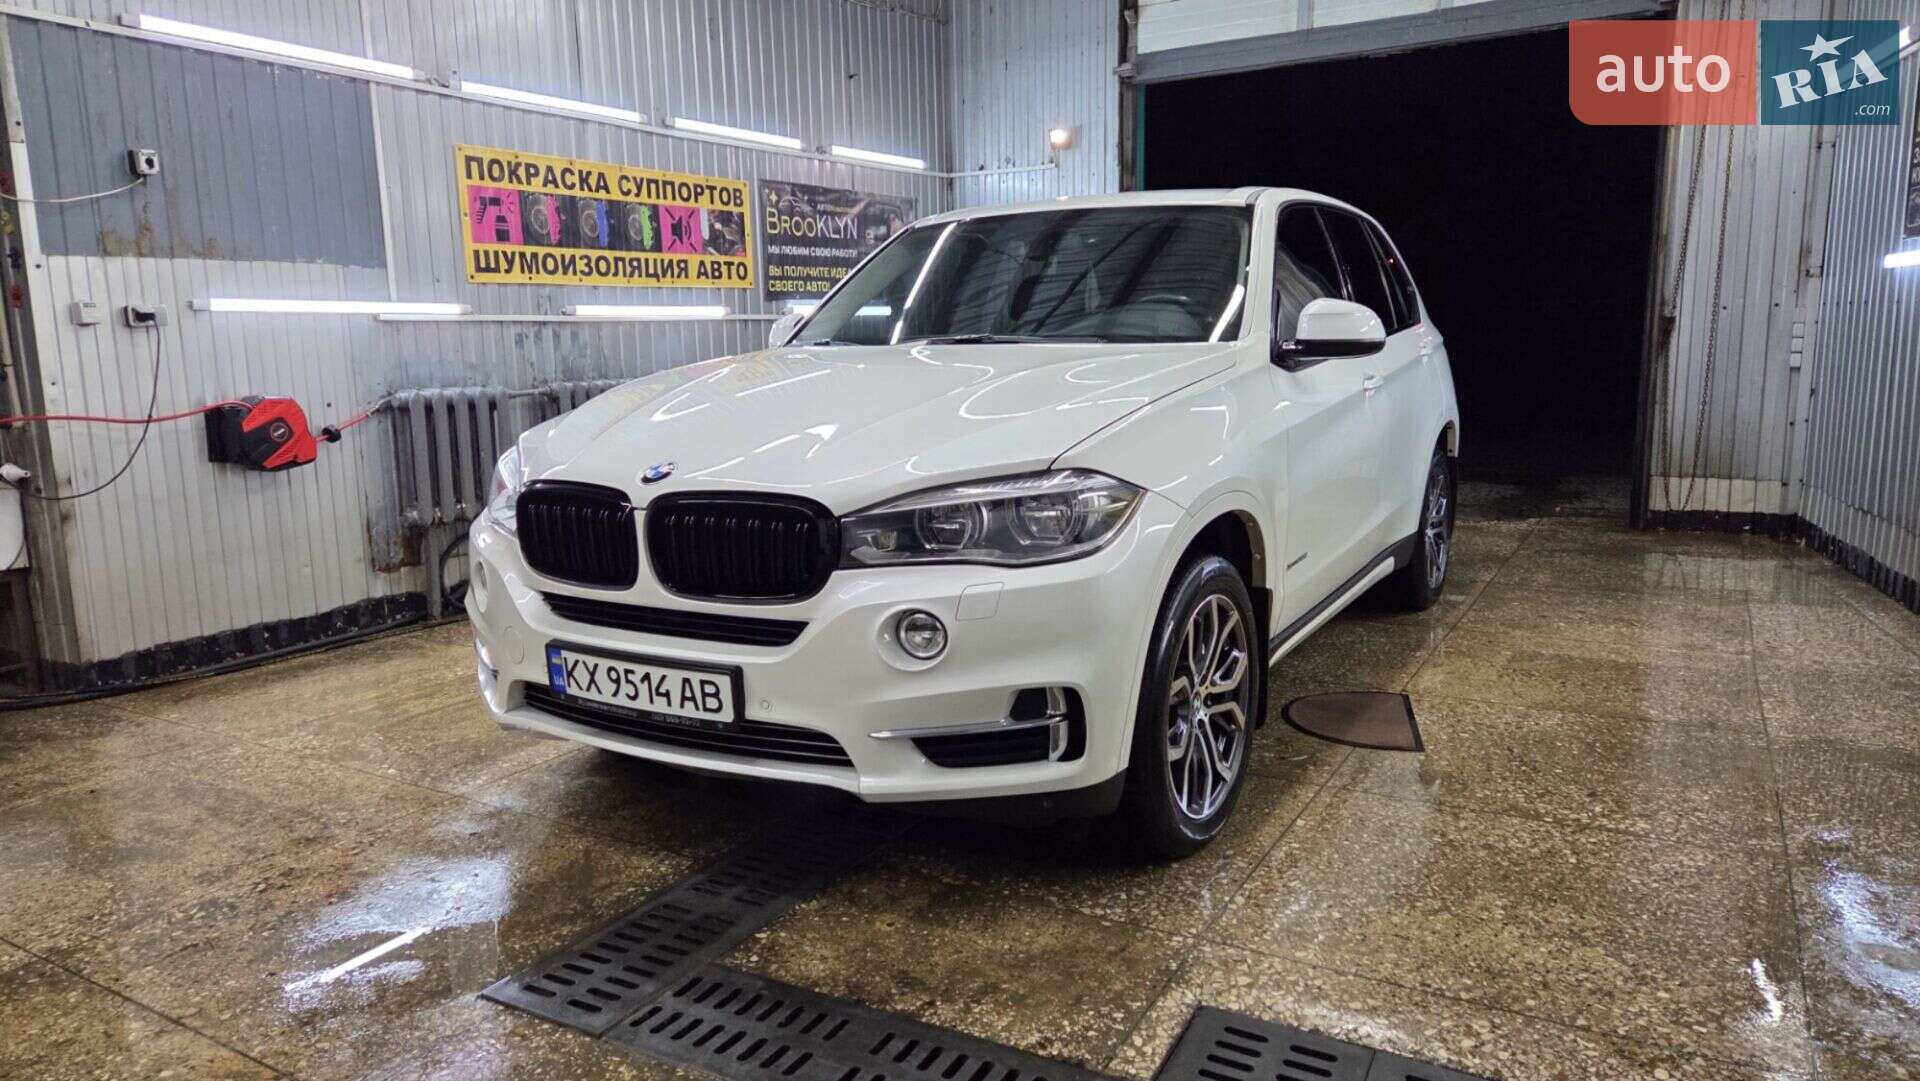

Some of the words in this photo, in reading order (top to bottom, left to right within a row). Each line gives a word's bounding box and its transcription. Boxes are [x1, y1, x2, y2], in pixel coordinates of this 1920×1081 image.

[464, 154, 611, 194] ПОКРАСКА
[617, 174, 744, 208] СУППОРТОВ
[768, 244, 780, 255] МЫ
[781, 245, 810, 256] ЛЮБИМ
[810, 246, 831, 257] СВОЮ
[472, 249, 690, 280] ШУМОИЗОЛЯЦИЯ
[696, 260, 748, 281] АВТО
[768, 265, 783, 277] ВЫ
[783, 265, 830, 278] ПОЛУЧИТЕ
[768, 280, 805, 292] СВОЕГО
[564, 656, 603, 695] KX
[606, 665, 673, 708] 9514
[679, 677, 724, 714] AB
